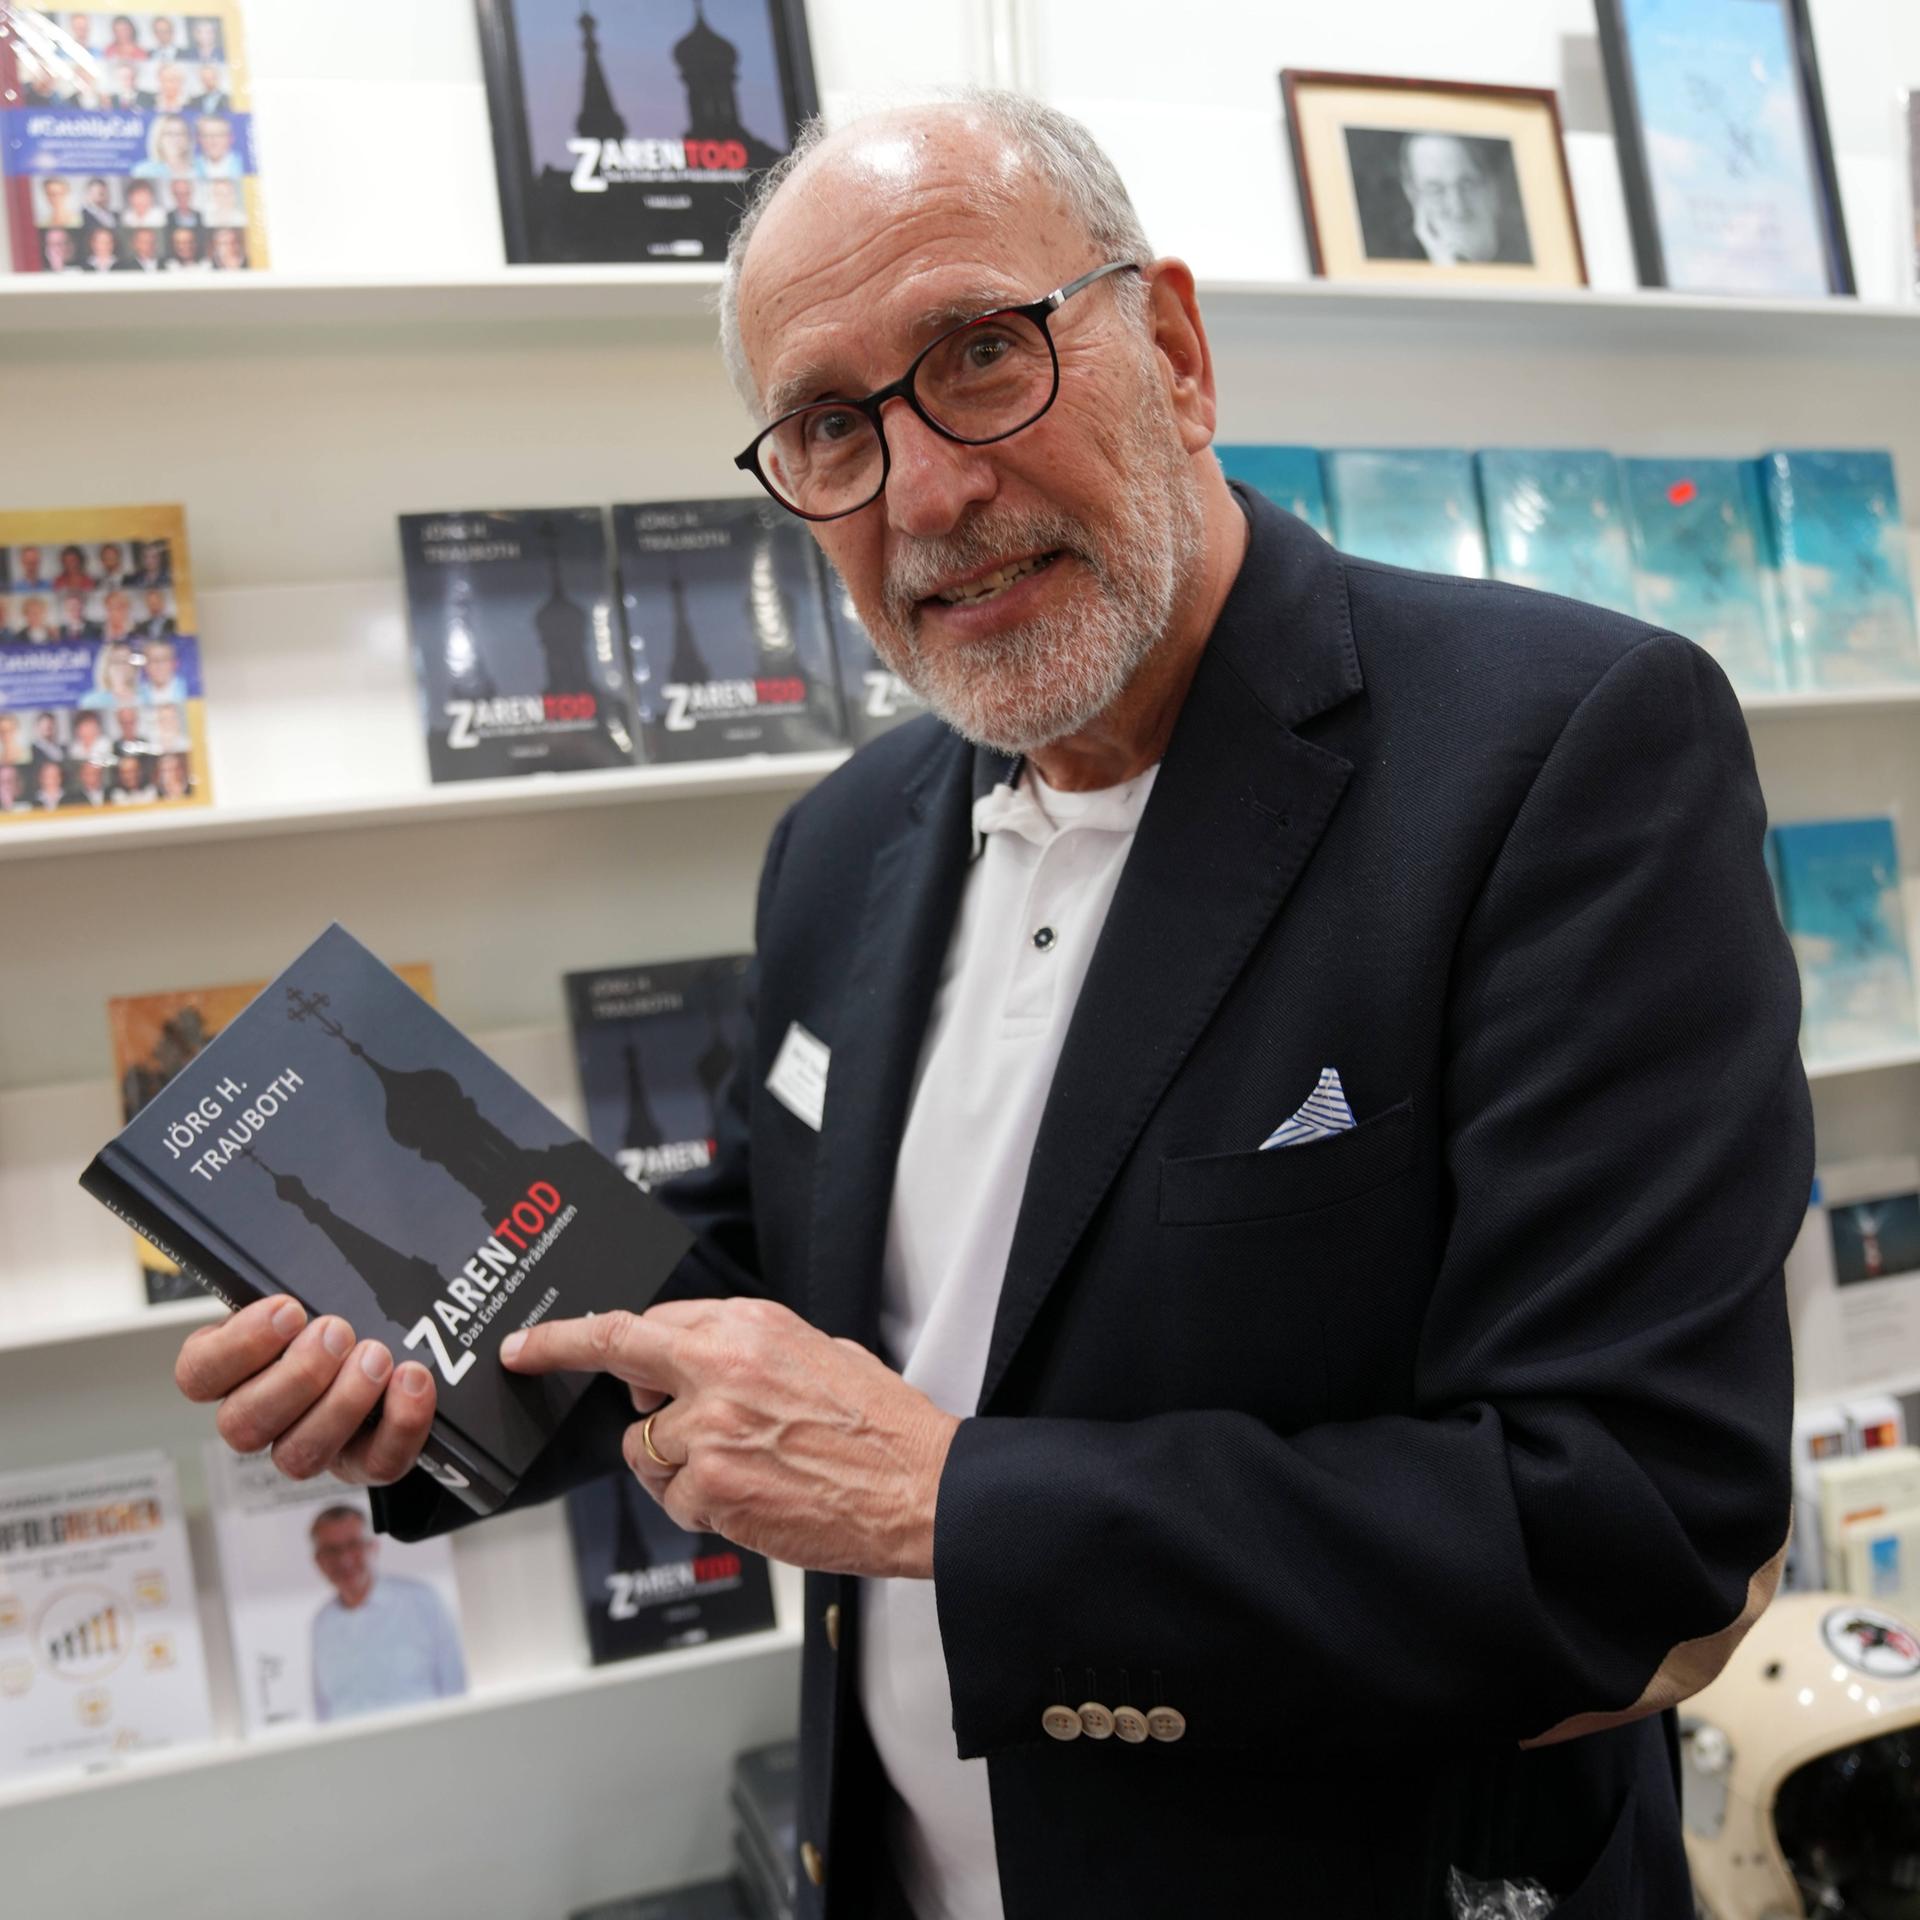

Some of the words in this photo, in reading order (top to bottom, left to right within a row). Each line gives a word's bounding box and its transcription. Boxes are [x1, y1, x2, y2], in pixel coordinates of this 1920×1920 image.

[566, 137, 748, 192] ZARENTOD
[444, 692, 597, 750] ZARENTOD
[661, 676, 807, 732] ZARENTOD
[163, 1096, 223, 1159] JÖRG
[215, 1076, 248, 1102] H.
[190, 1067, 304, 1181] TRAUBOTH
[614, 1138, 718, 1194] ZAREN
[402, 1180, 562, 1386] ZARENTOD
[459, 1320, 484, 1348] Das
[480, 1291, 508, 1324] Ende
[503, 1268, 525, 1294] des
[519, 1203, 578, 1273] Präsidenten
